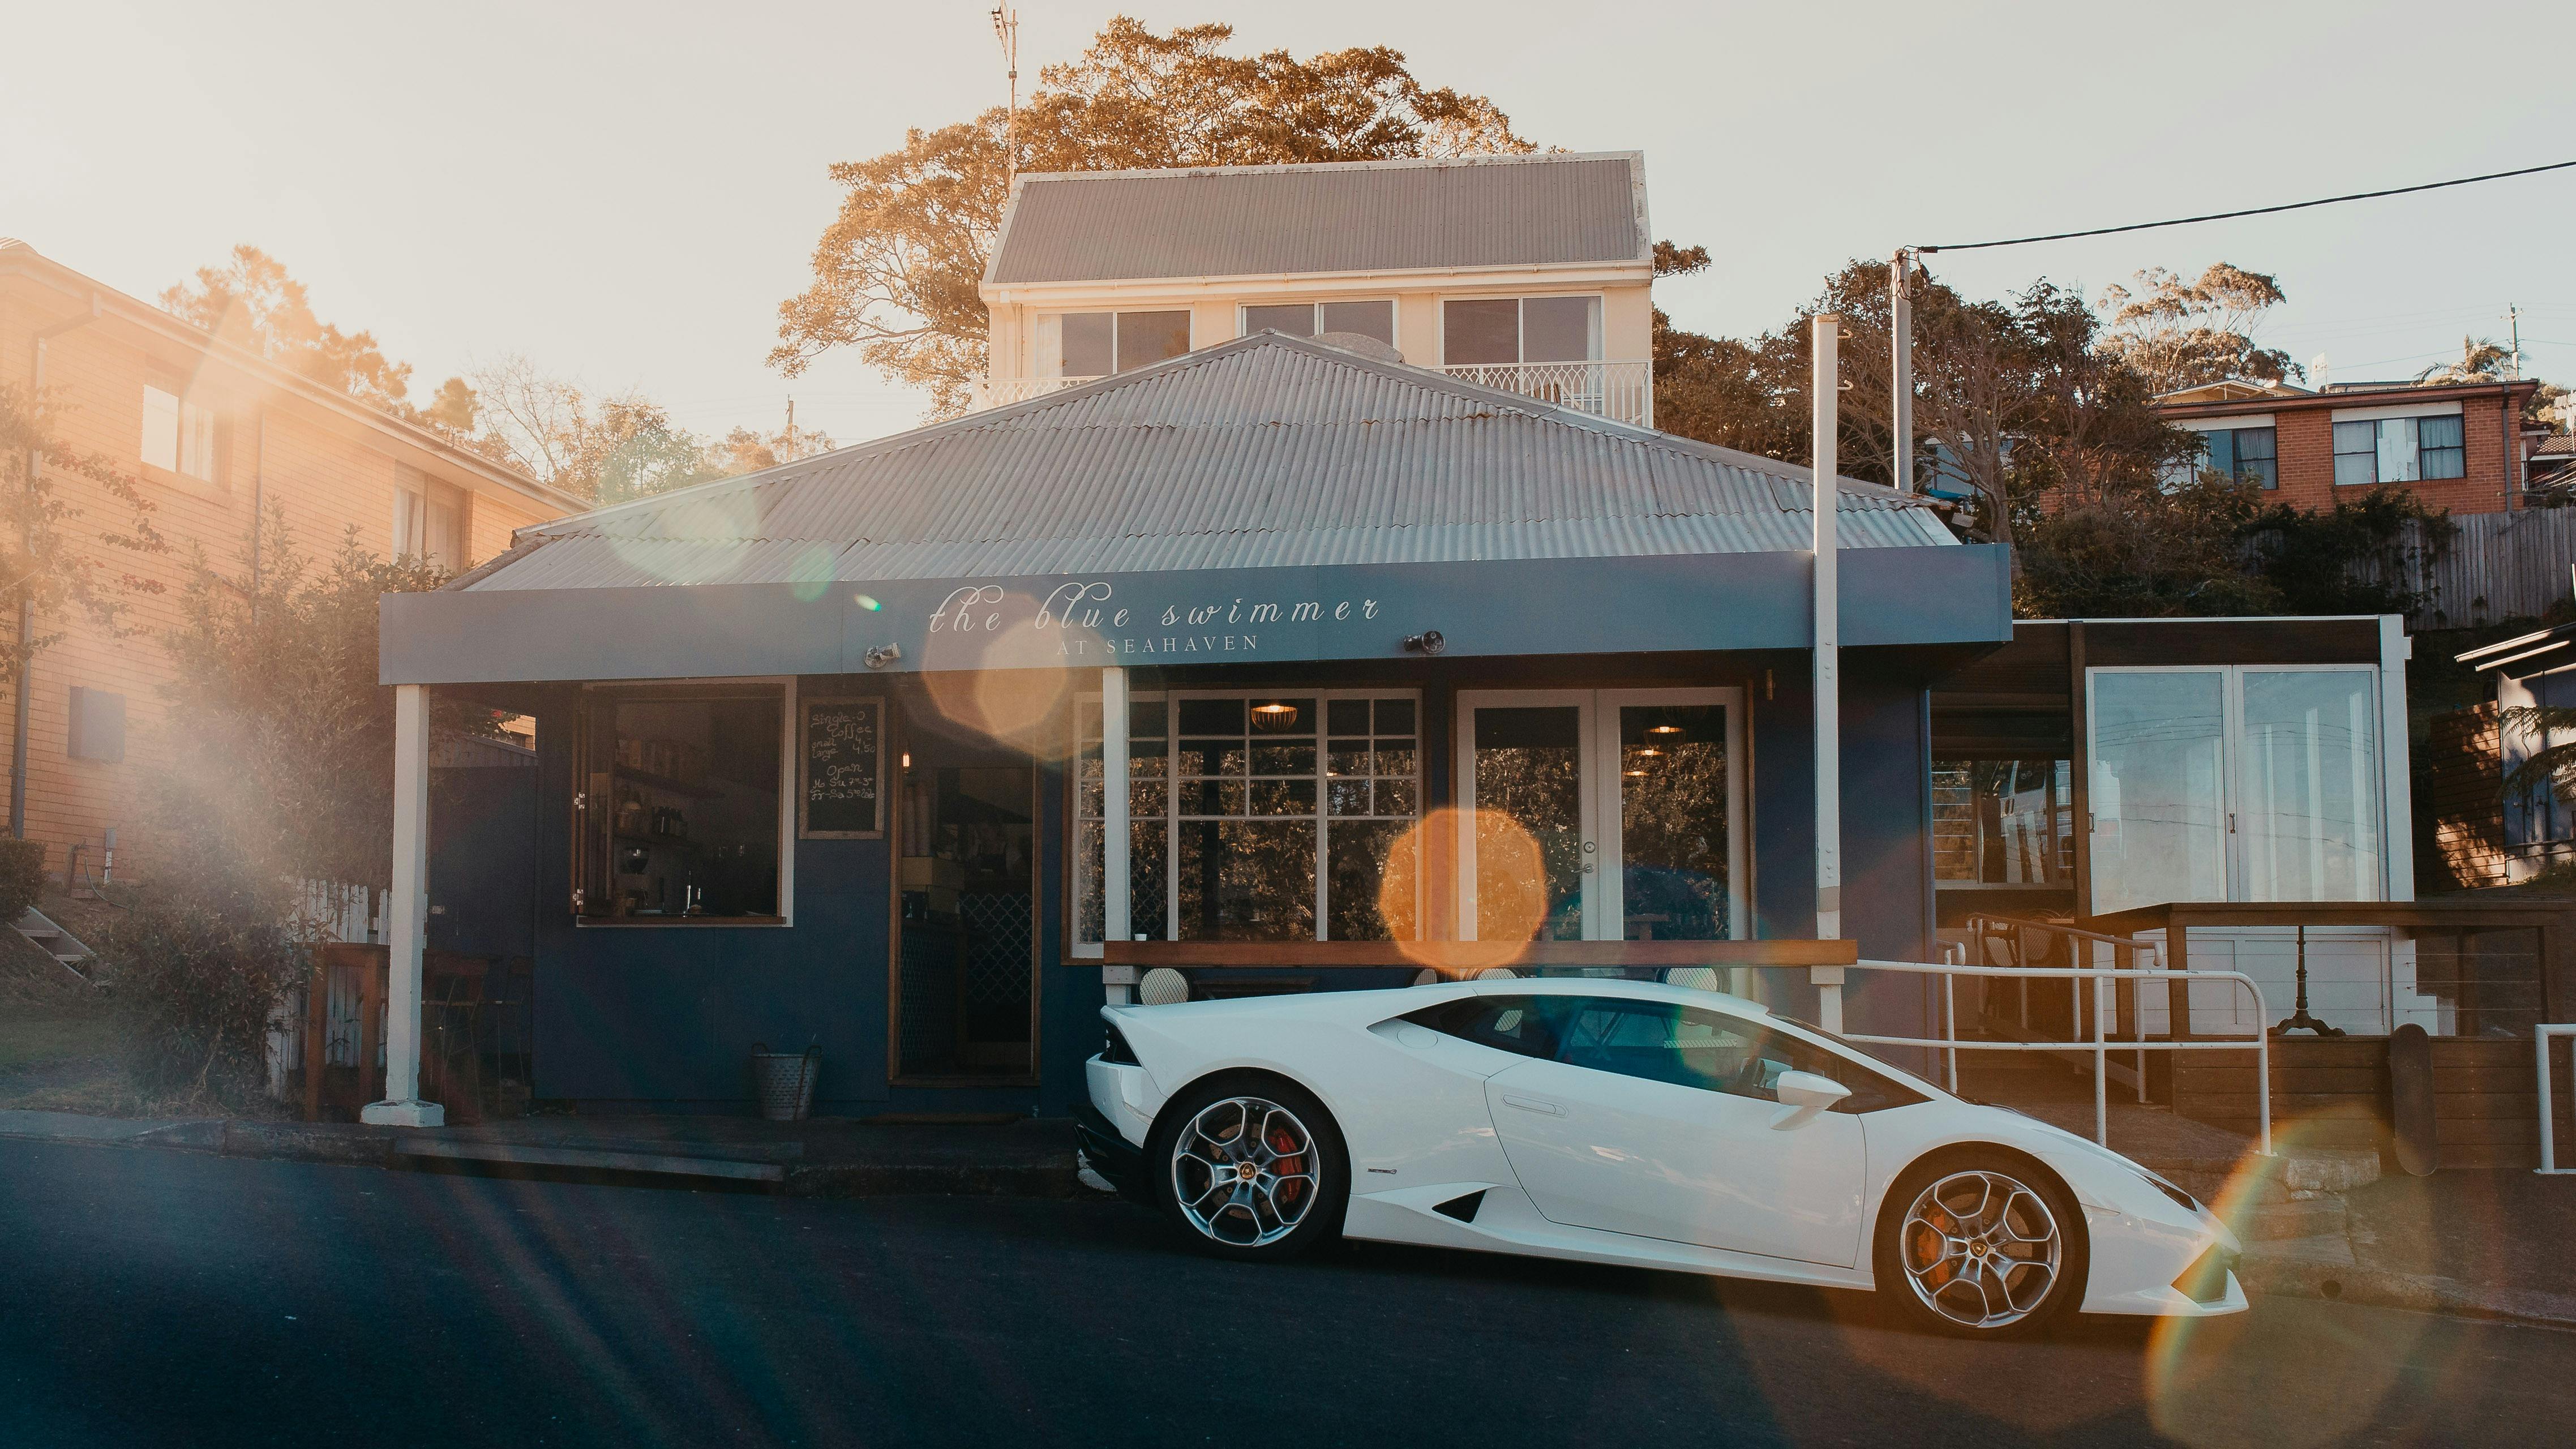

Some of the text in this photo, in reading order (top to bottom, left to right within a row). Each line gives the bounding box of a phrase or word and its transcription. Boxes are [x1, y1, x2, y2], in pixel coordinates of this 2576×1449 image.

[929, 582, 1380, 633] the blue swimmer
[1057, 635, 1257, 655] AT SEAHAVEN
[827, 764, 863, 781] Open
